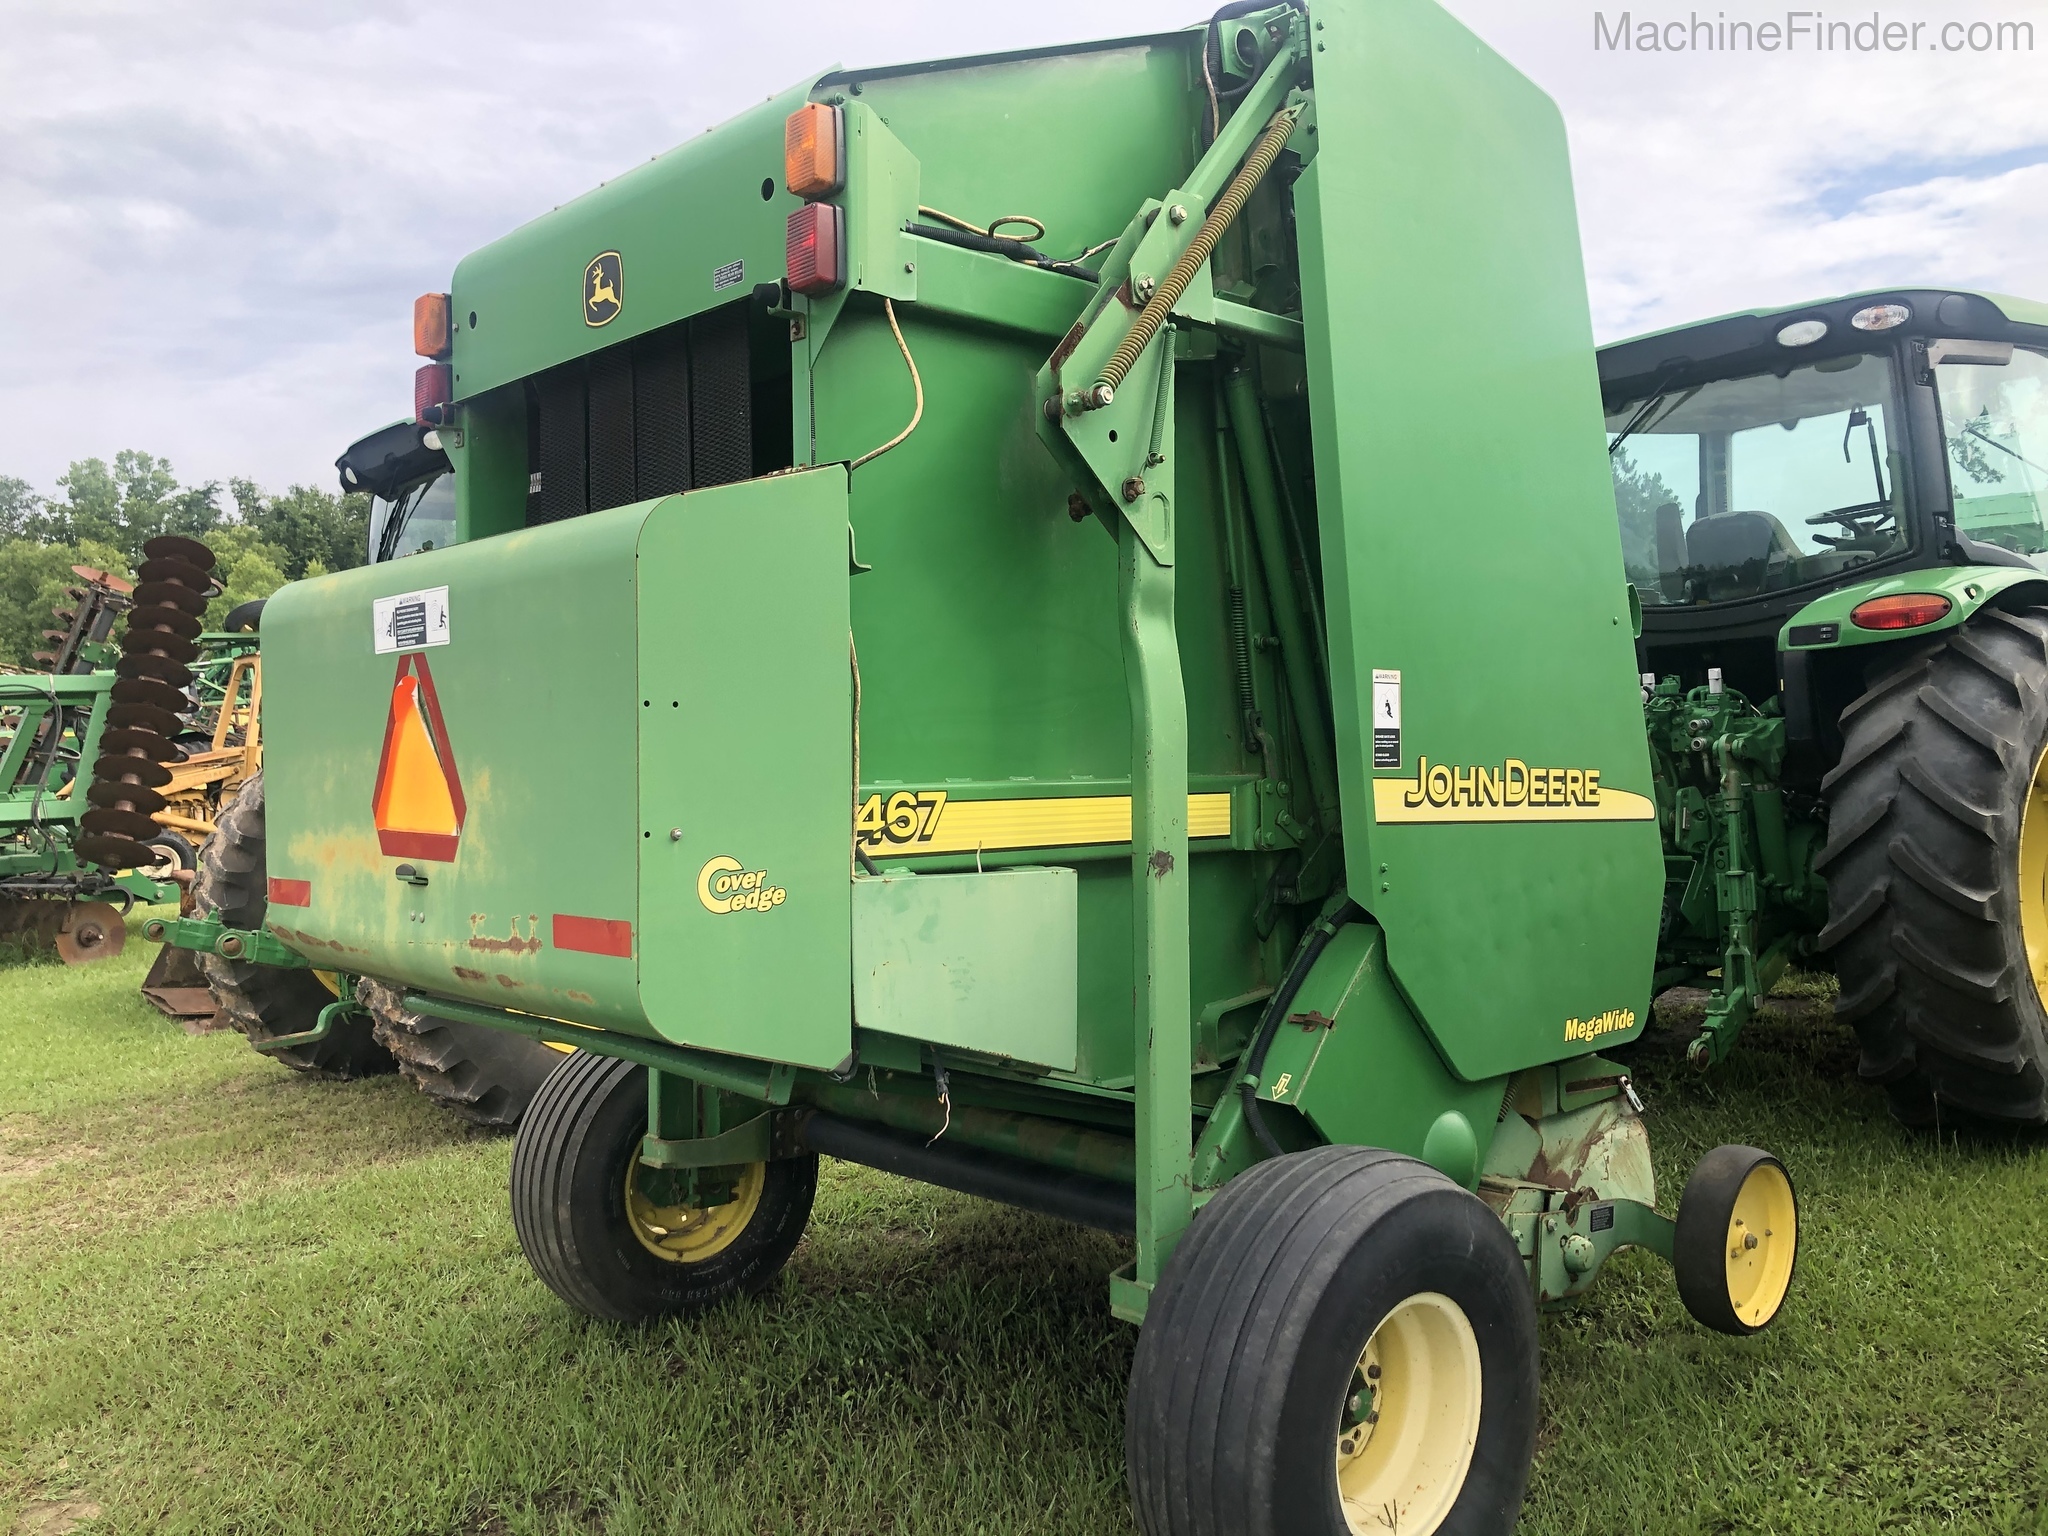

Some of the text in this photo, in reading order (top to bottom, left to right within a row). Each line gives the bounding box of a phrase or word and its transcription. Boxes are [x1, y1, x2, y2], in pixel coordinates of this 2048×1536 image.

[1404, 755, 1601, 809] JOHN DEERE
[857, 790, 948, 845] 467
[697, 855, 768, 914] Cover
[1563, 1007, 1636, 1043] MegaWide
